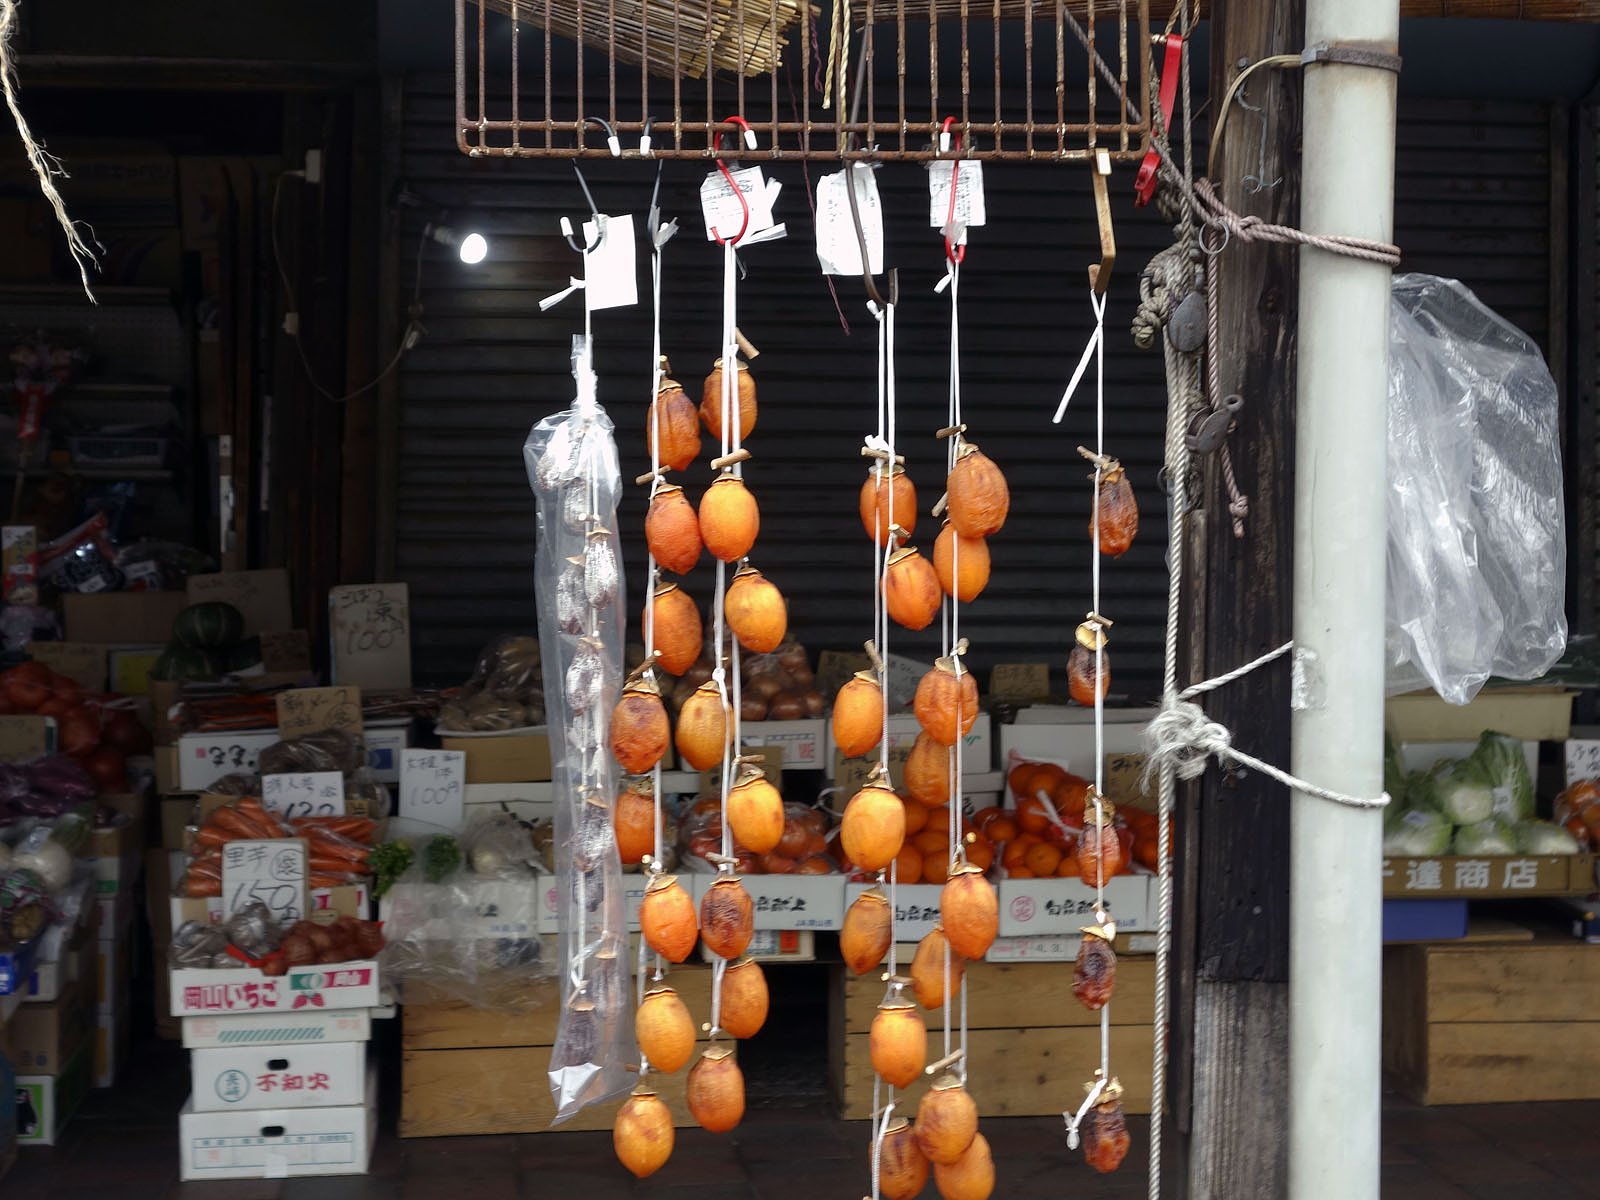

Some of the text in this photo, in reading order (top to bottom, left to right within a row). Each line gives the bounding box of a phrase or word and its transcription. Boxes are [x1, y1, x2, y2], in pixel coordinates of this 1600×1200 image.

[184, 981, 279, 1010] 岡山いちご
